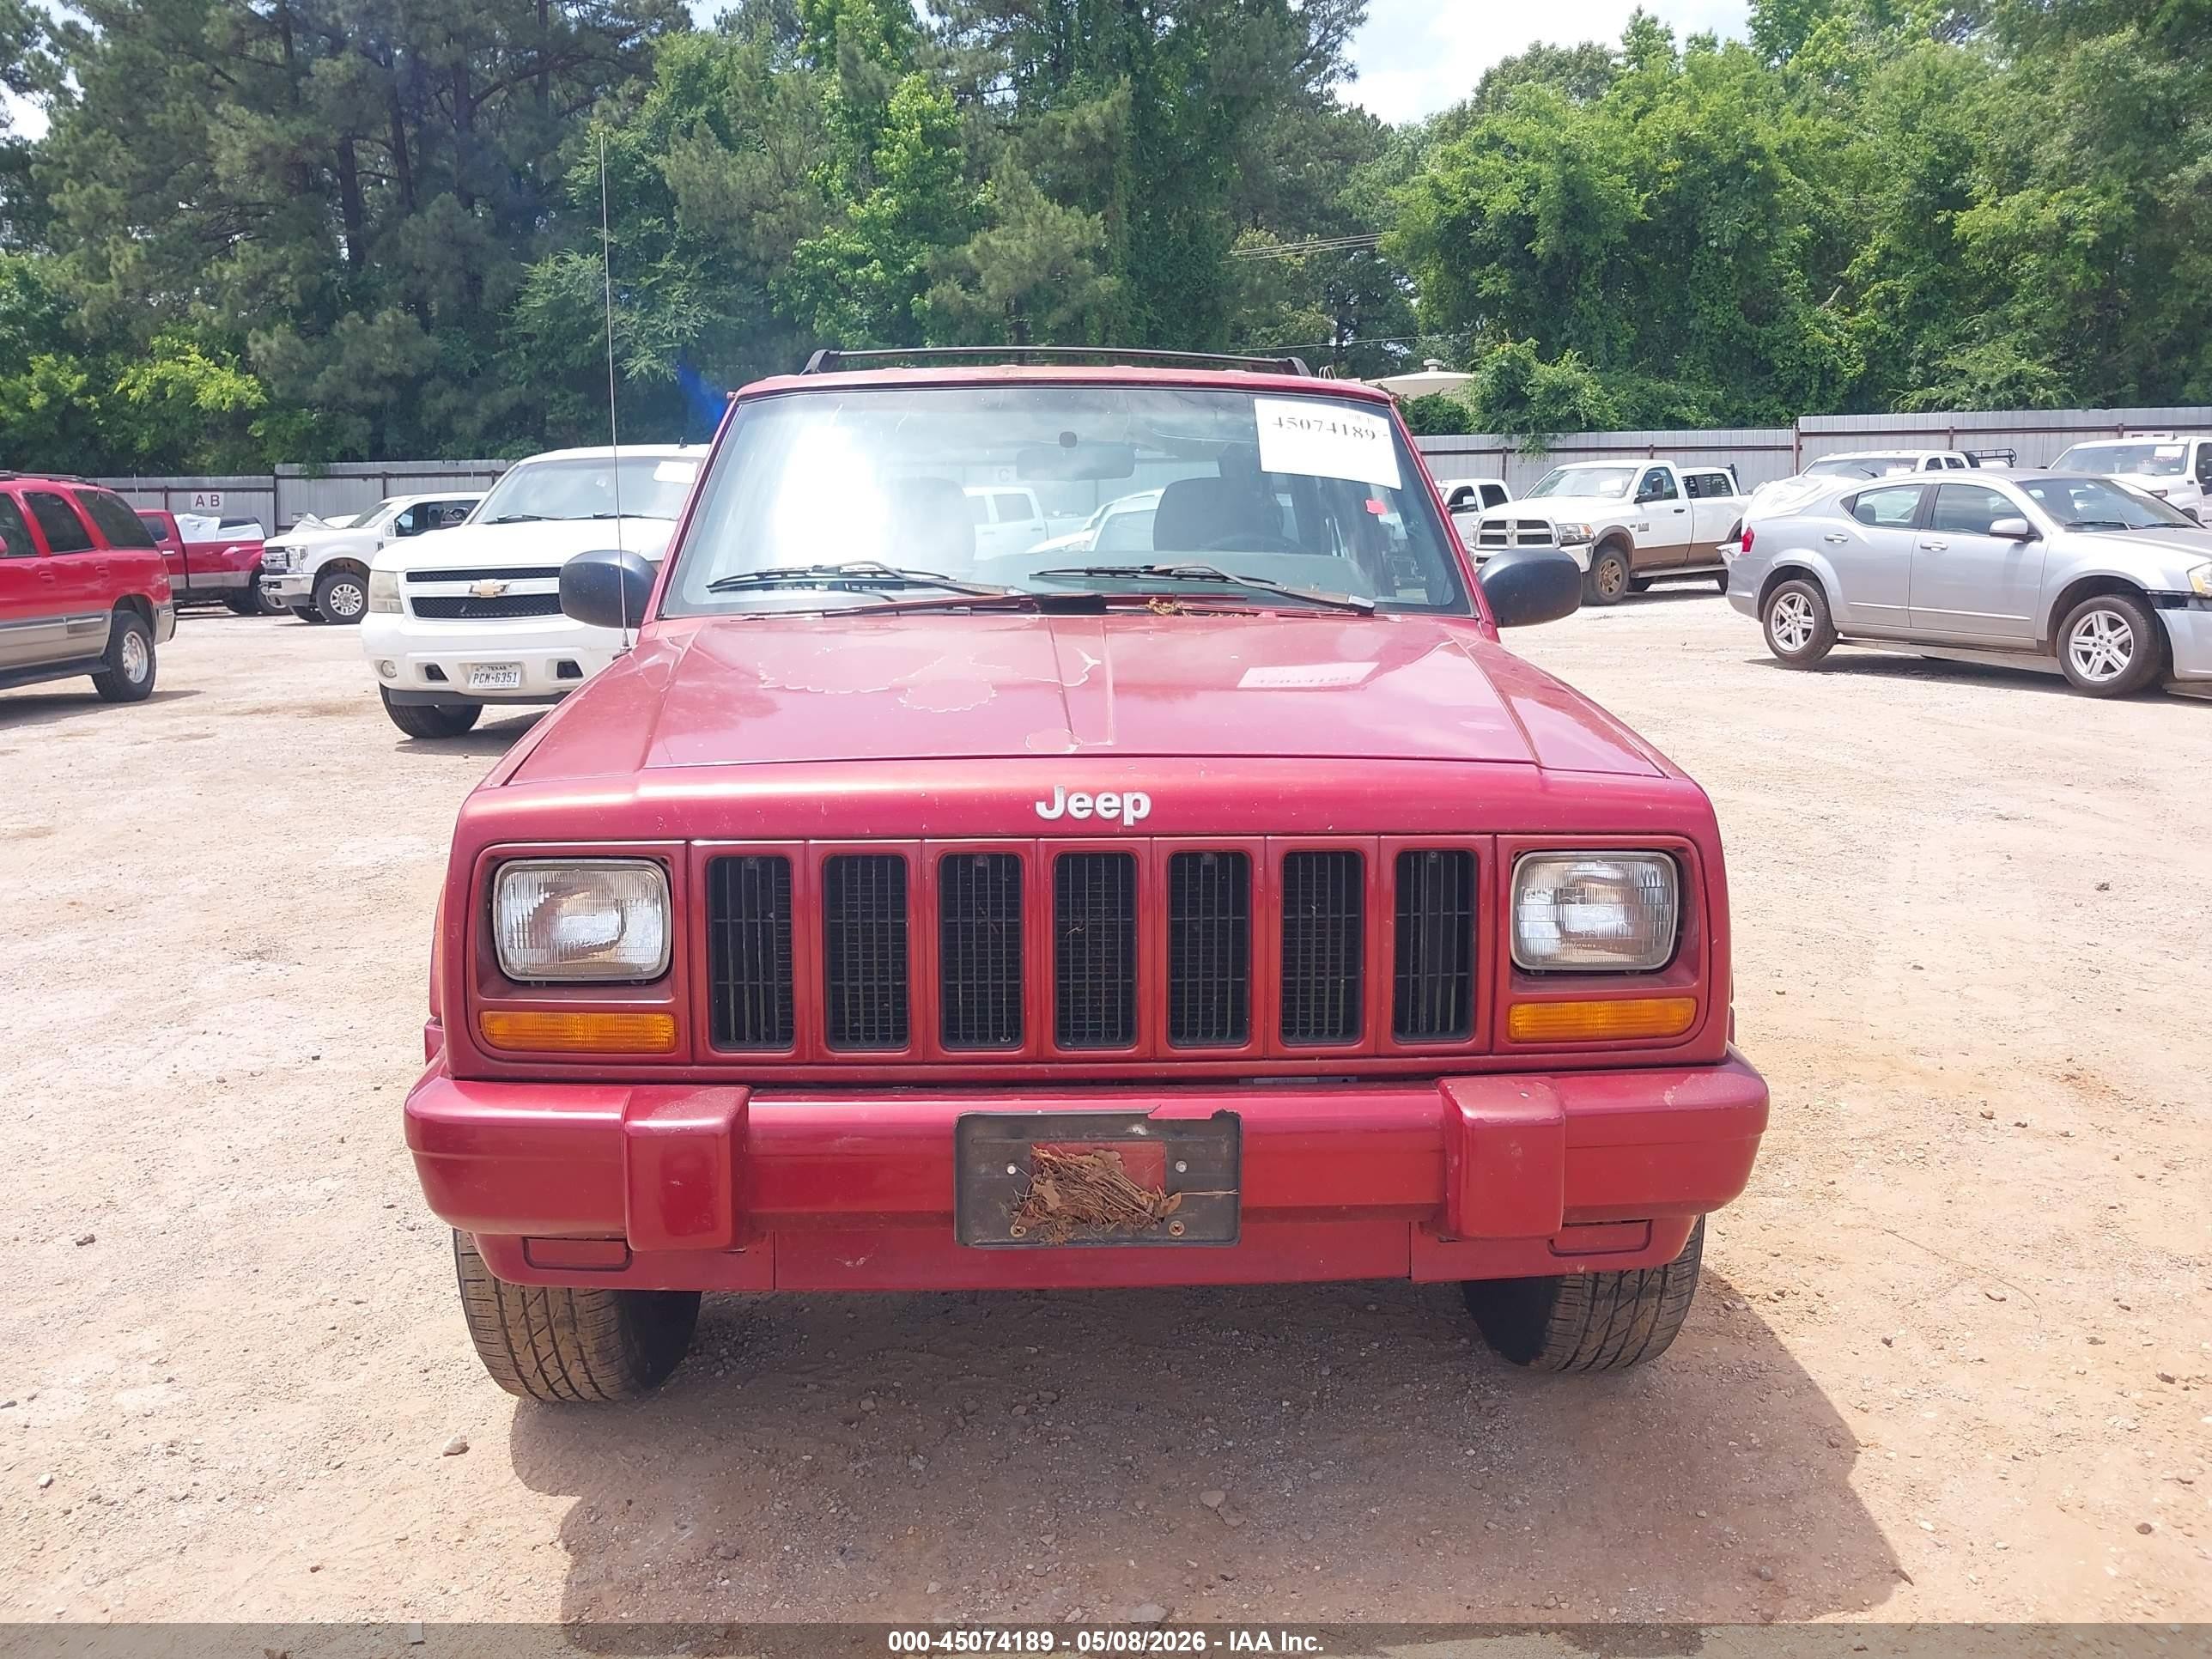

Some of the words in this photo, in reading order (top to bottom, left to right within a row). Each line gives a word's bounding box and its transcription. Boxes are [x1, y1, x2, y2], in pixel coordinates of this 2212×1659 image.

[1272, 416, 1376, 441] 45074189
[195, 495, 205, 507] A
[210, 495, 221, 507] B
[1036, 784, 1152, 826] Jeep
